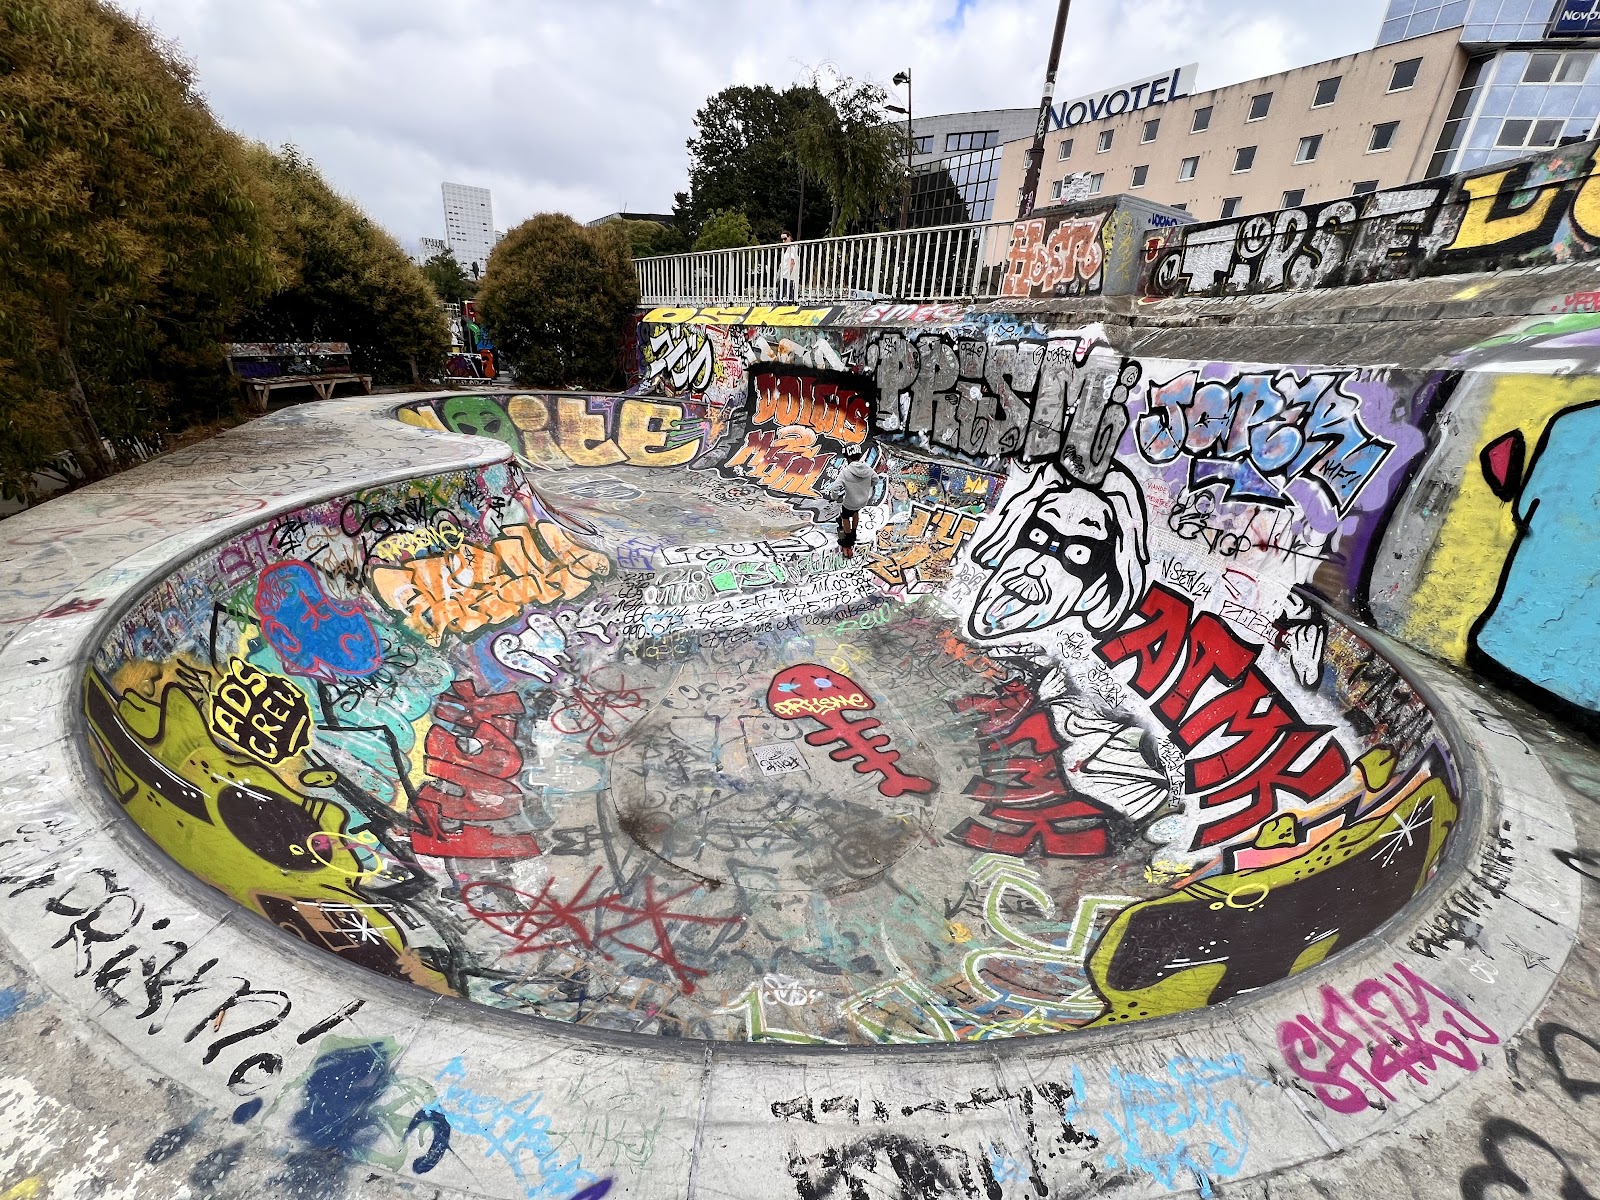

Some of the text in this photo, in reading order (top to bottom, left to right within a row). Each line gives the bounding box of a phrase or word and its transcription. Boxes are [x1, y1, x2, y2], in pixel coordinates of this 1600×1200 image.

[1050, 67, 1188, 129] NOVOTEL
[215, 658, 269, 743] ADS
[249, 681, 304, 760] CREW
